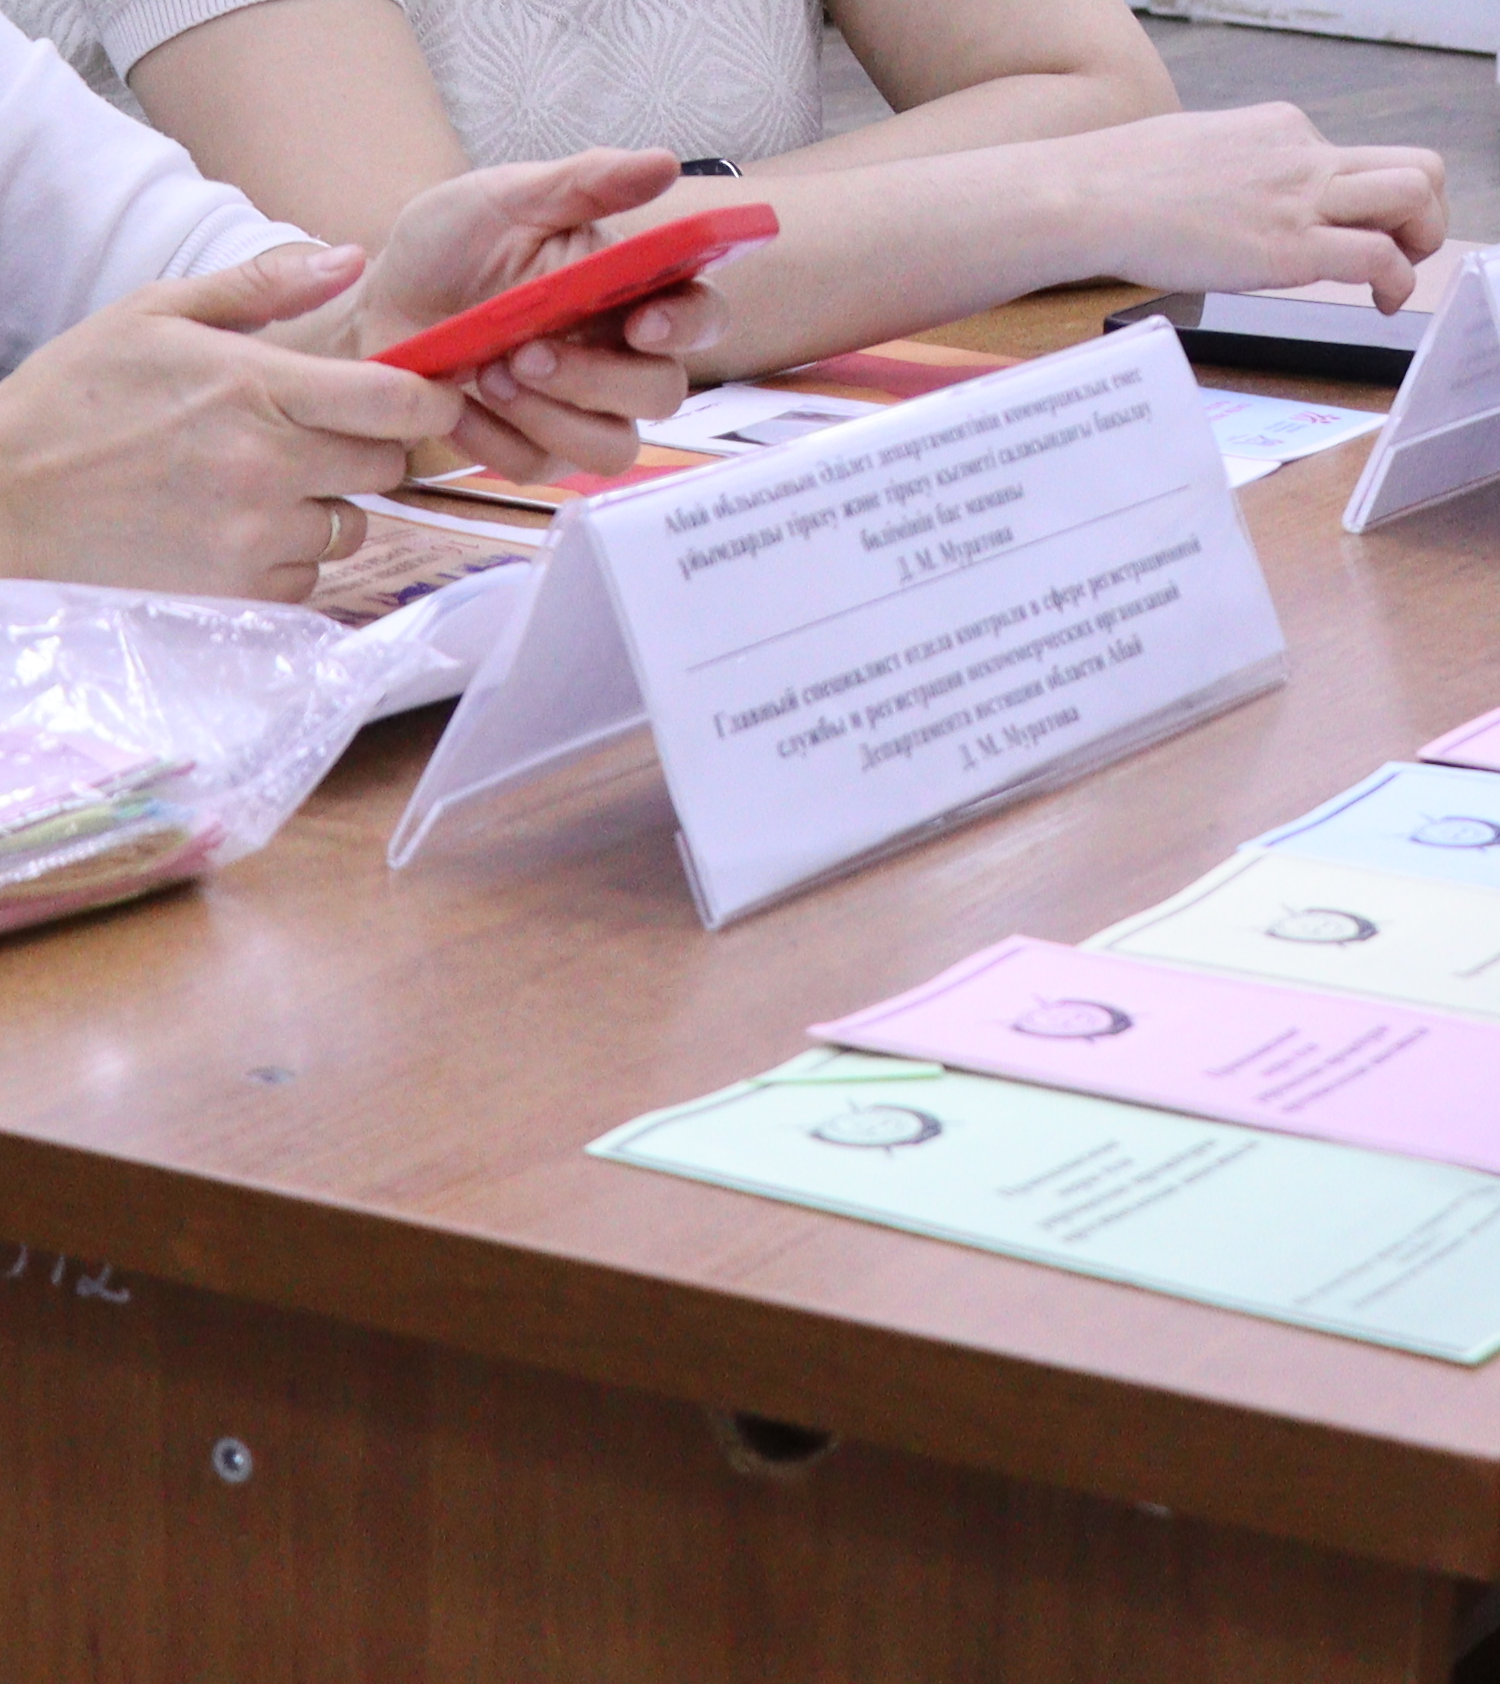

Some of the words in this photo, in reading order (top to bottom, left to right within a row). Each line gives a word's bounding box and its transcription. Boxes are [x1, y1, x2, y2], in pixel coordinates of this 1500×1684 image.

[1043, 583, 1085, 612] сфере
[776, 716, 847, 758] службы
[849, 711, 862, 728] и
